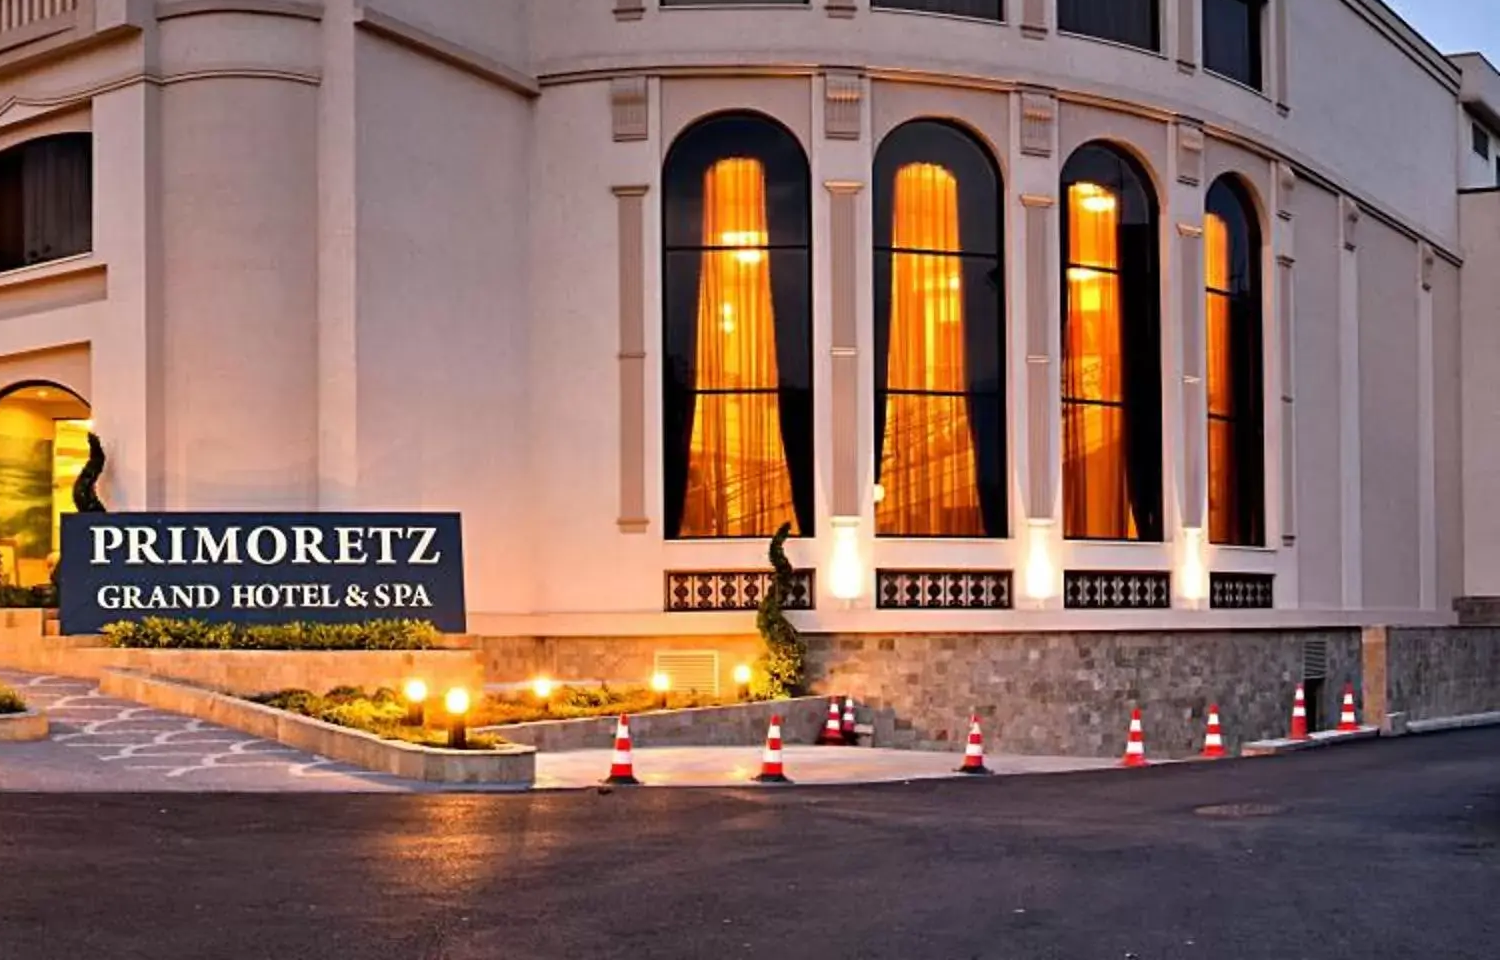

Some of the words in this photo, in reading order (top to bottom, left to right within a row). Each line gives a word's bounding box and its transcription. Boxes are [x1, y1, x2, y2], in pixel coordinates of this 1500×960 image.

[89, 526, 441, 565] PRIMORETZ
[97, 584, 220, 609] GRAND
[231, 583, 340, 608] HOTEL
[344, 583, 369, 607] &
[374, 583, 433, 607] SPA
